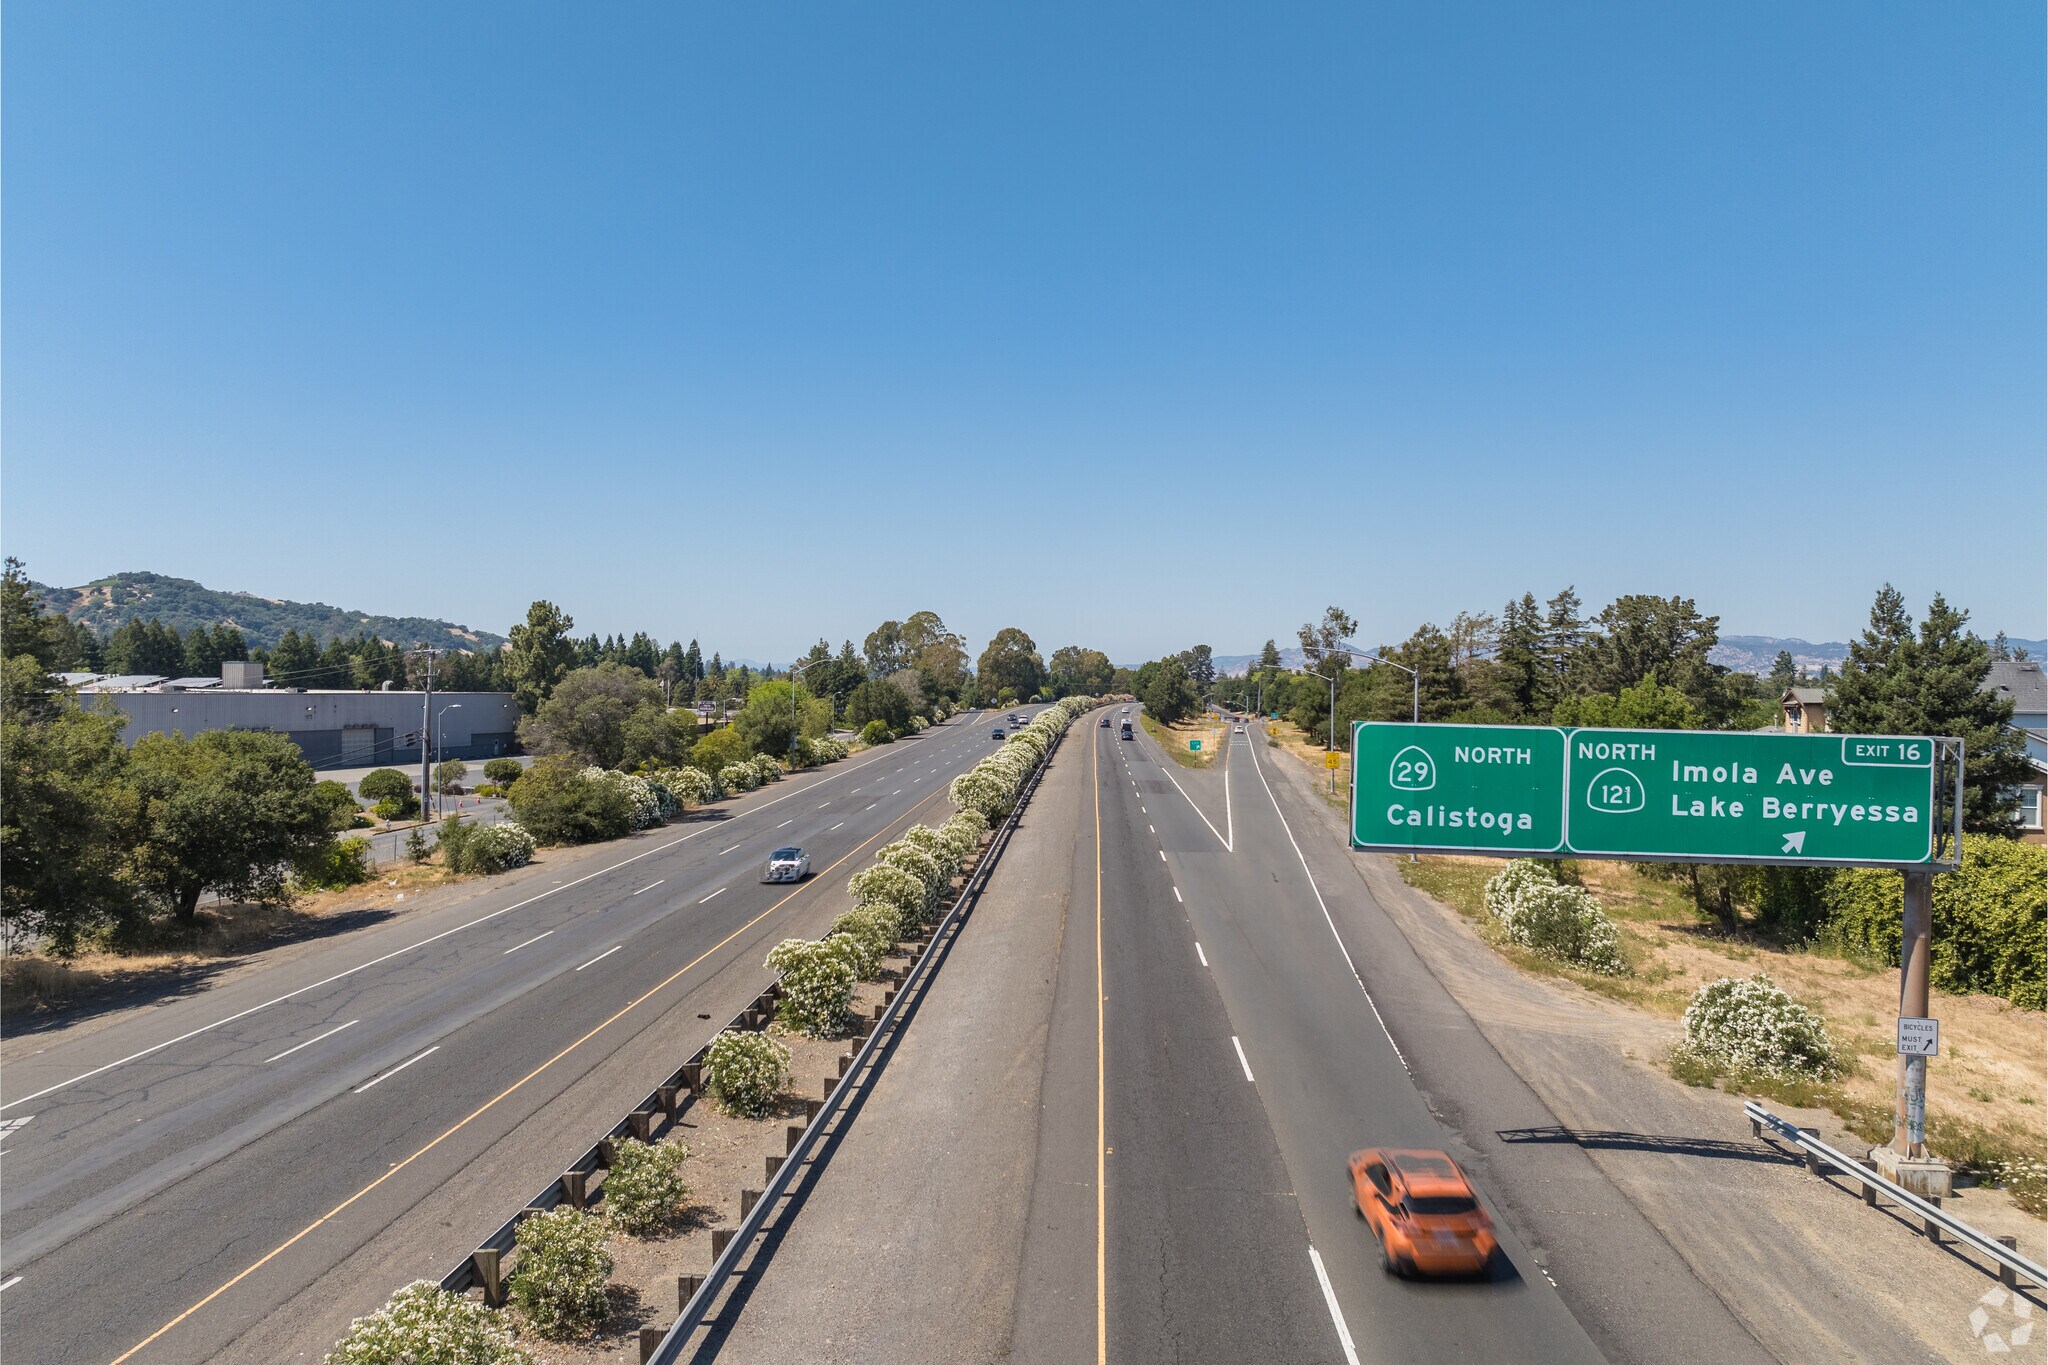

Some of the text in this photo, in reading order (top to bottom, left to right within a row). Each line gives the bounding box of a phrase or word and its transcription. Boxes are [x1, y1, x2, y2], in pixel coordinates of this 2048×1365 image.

[1455, 746, 1531, 765] NORTH
[1579, 742, 1656, 760] NORTH
[1856, 743, 1921, 760] EXIT 16
[1397, 761, 1428, 782] 29
[1672, 760, 1834, 786] Imola Ave
[1602, 785, 1631, 804] 121
[1387, 804, 1532, 836] Calistoga
[1672, 794, 1918, 826] Lake Berryessa
